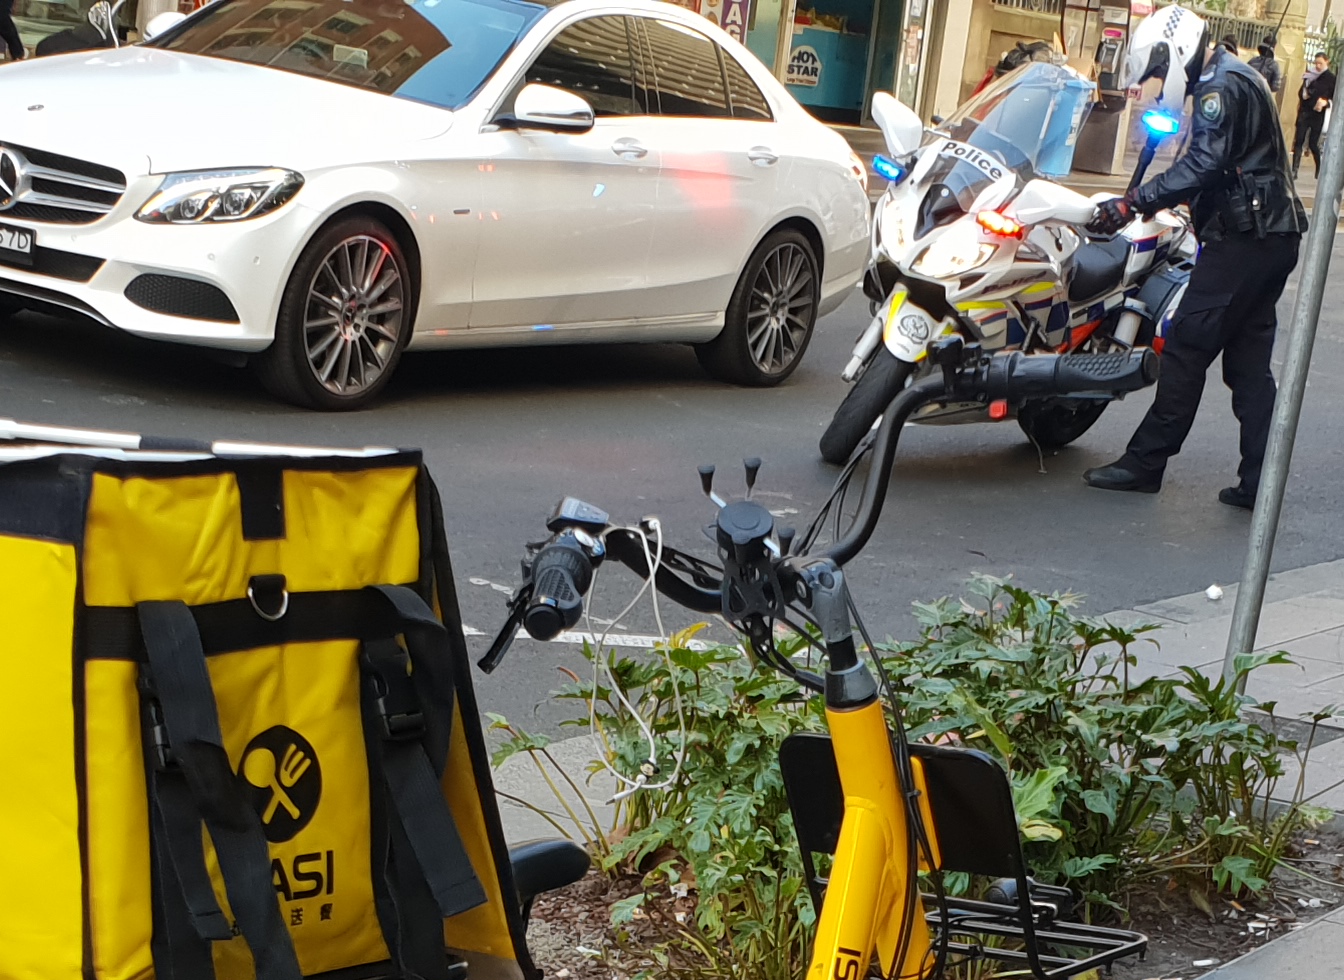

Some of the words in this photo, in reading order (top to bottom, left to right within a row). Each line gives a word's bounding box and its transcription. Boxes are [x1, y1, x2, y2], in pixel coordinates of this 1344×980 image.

[787, 63, 818, 77] STAR
[791, 50, 818, 65] HOT
[942, 142, 1003, 180] Police
[271, 849, 334, 902] ASI
